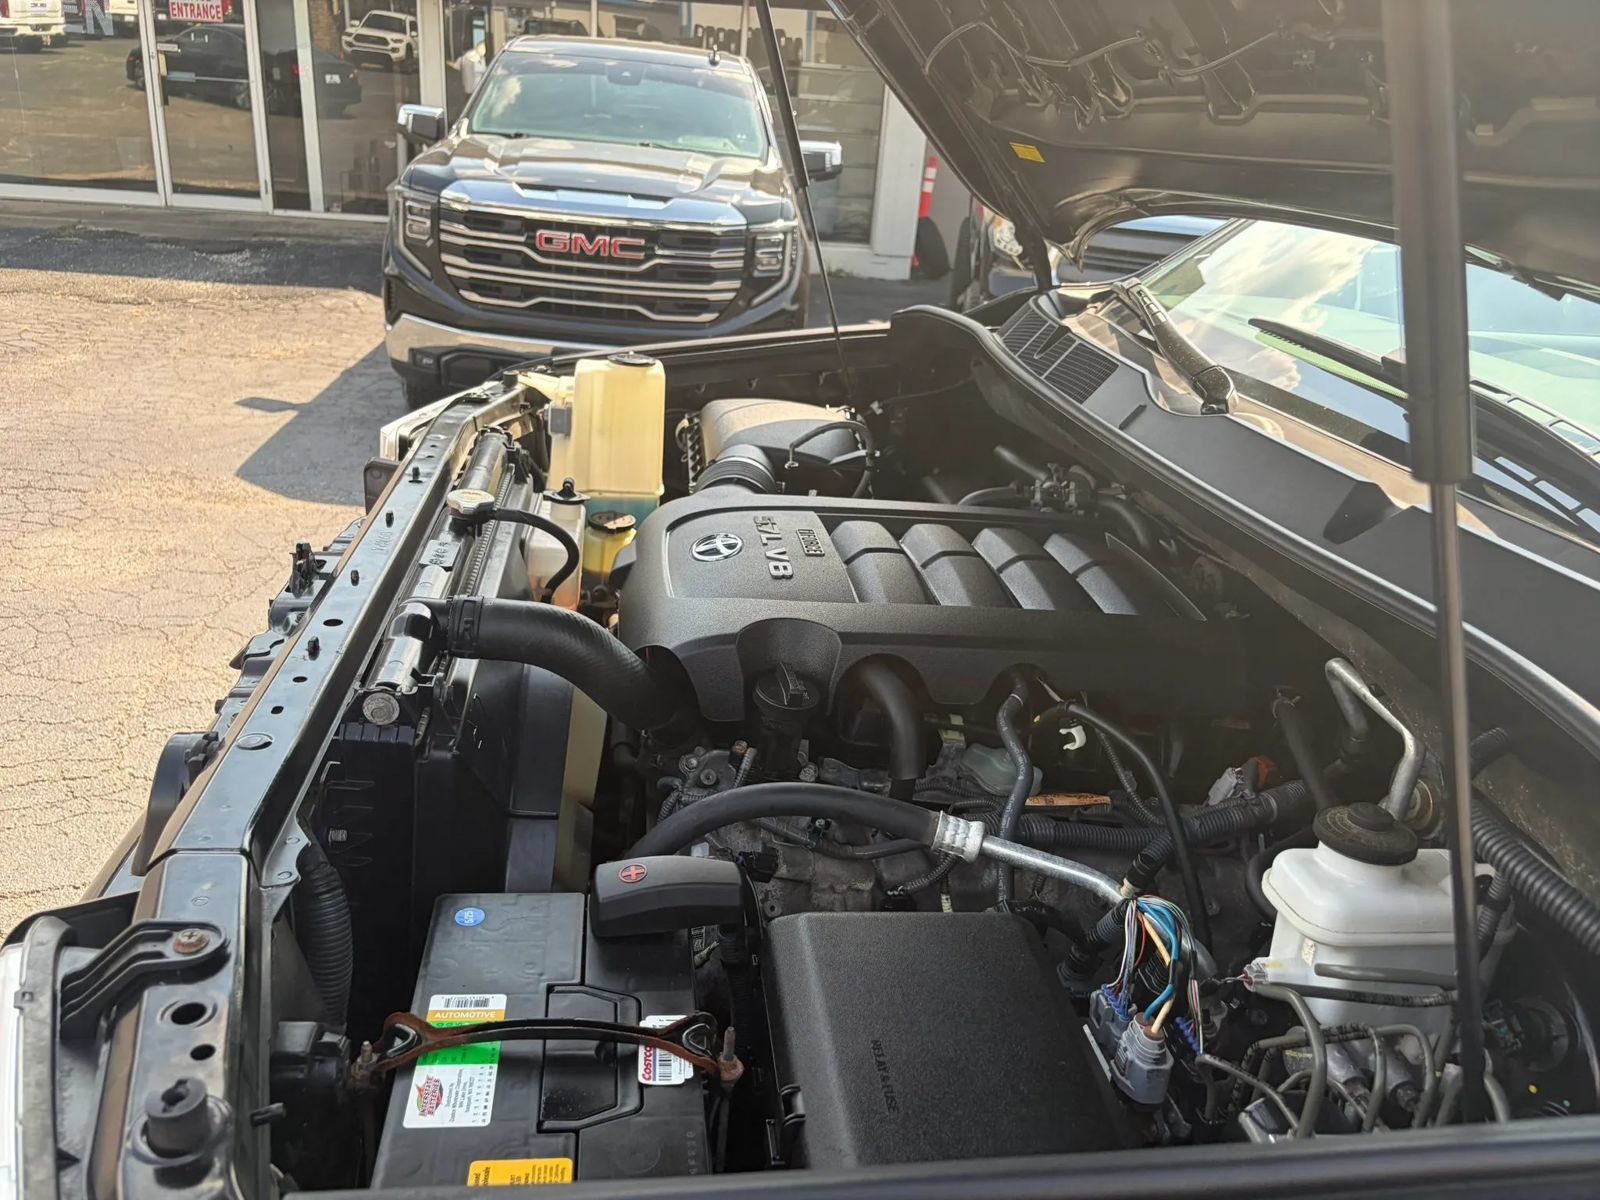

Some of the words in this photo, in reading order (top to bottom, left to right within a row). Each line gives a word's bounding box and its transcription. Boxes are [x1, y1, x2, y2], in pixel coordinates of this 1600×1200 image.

[170, 2, 222, 20] ENTRANCE
[535, 229, 646, 260] GMC
[765, 547, 793, 578] V8
[434, 1011, 497, 1019] AUTOMOTIVE
[870, 1040, 889, 1073] RELAY
[881, 1085, 900, 1114] FUSE
[418, 1074, 433, 1117] INTERSTATE
[426, 1078, 440, 1116] BATTERIES
